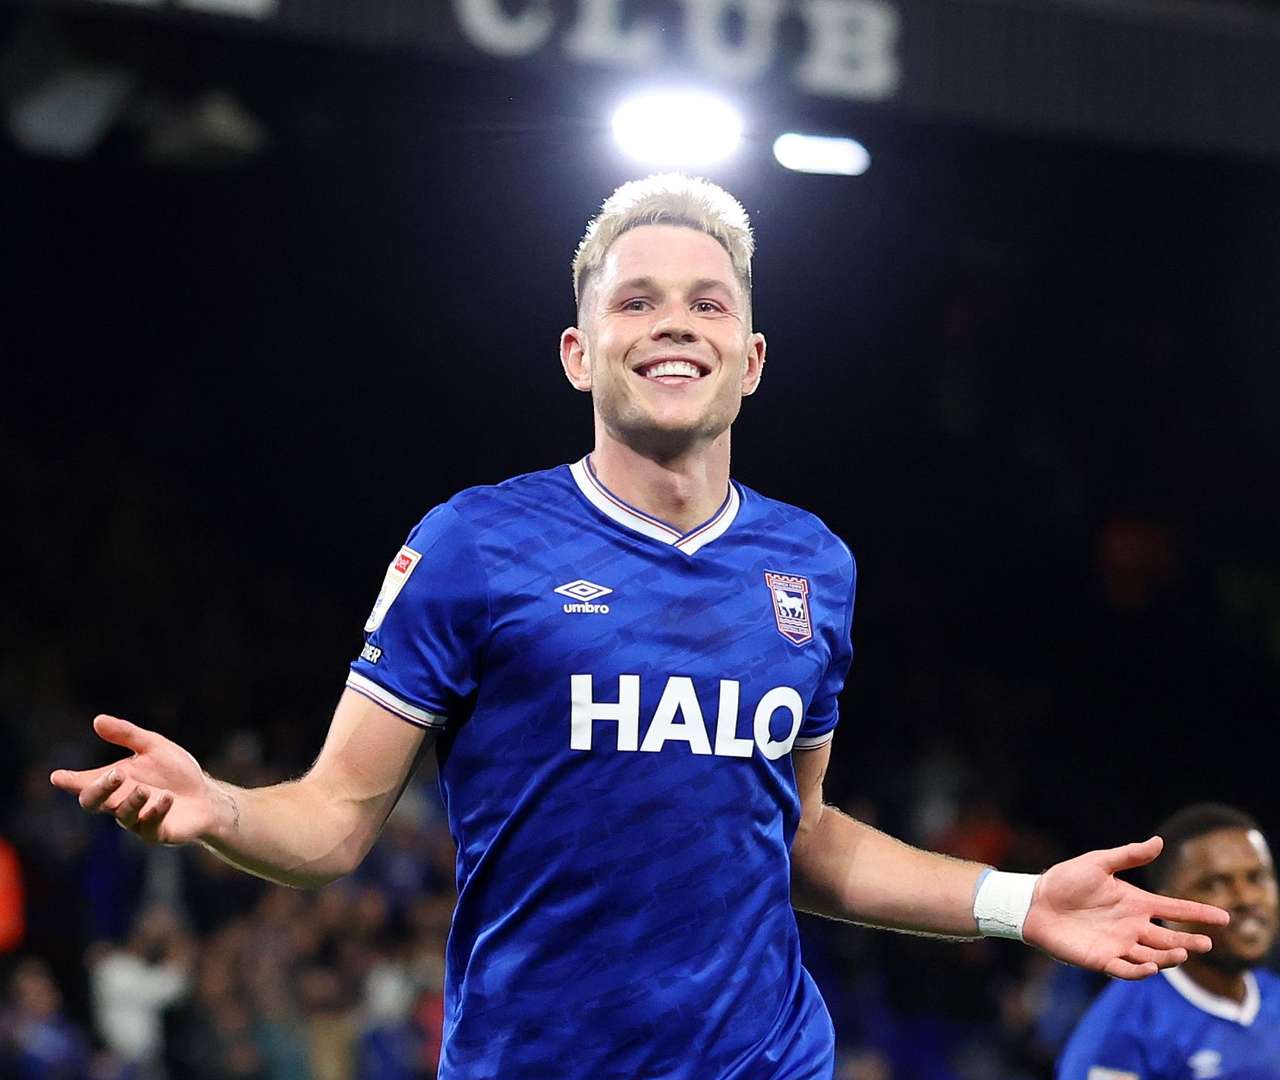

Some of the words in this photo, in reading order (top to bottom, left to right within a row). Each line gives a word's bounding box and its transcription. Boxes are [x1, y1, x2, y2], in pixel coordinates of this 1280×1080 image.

[453, 0, 901, 97] CLUB
[563, 601, 610, 615] umbro
[570, 674, 803, 761] HALO
